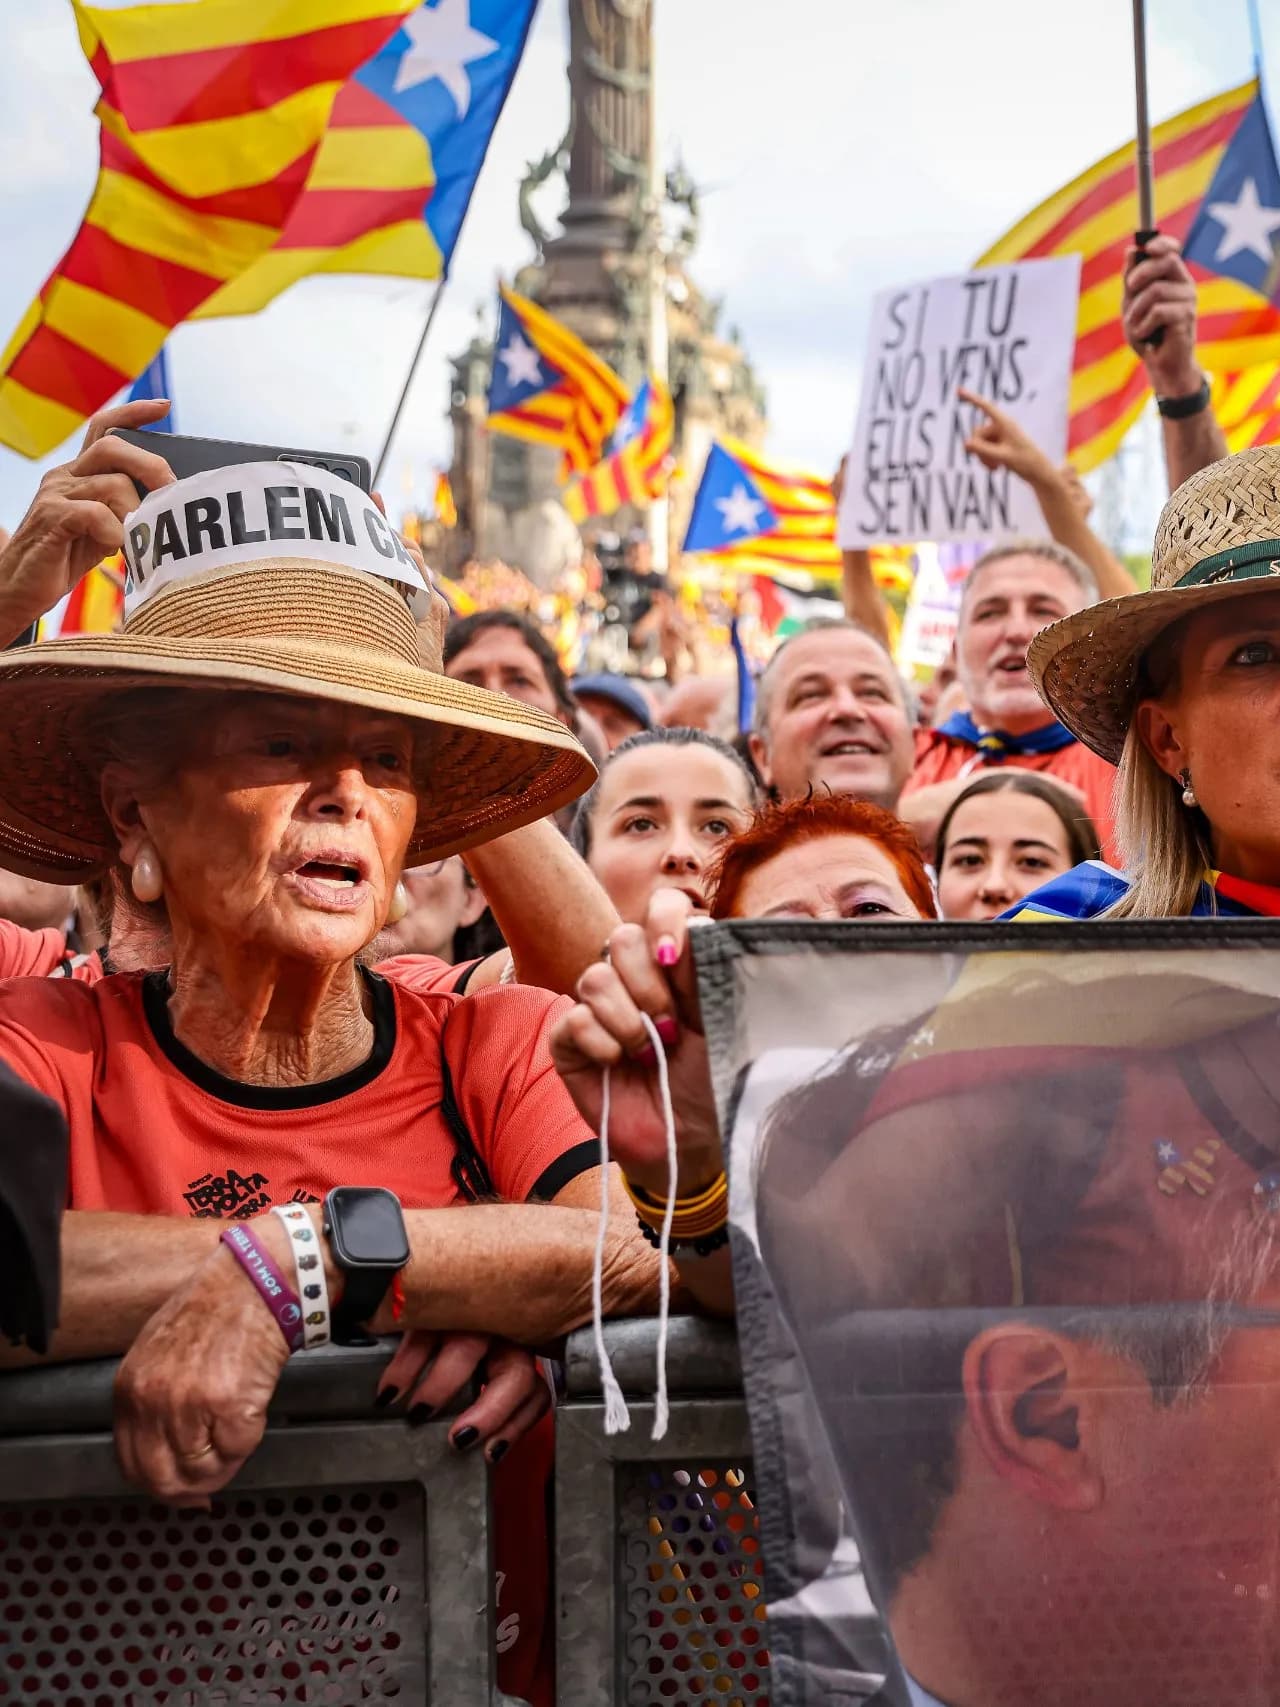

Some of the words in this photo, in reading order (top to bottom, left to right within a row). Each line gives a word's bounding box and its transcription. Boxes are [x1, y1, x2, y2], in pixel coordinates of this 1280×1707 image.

[882, 288, 930, 351] SI
[963, 272, 1018, 341] TU
[871, 350, 926, 414] NO
[866, 409, 936, 472] ELLS
